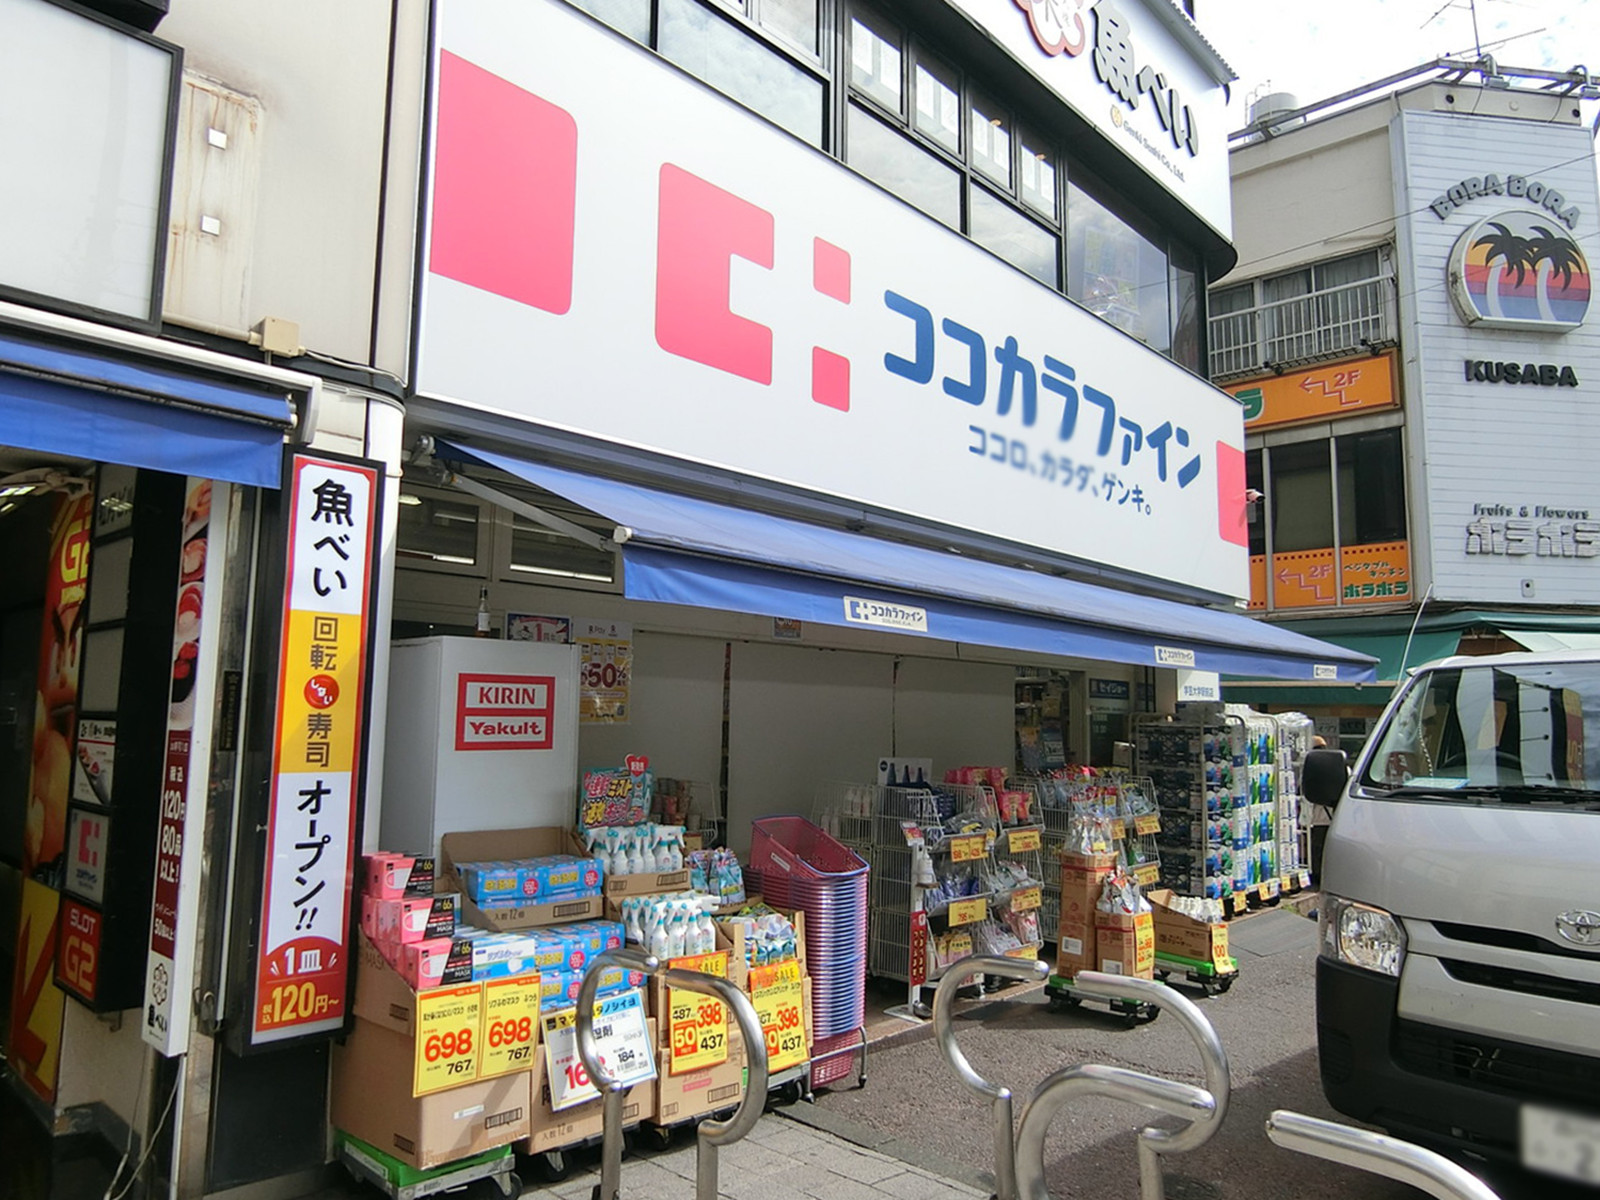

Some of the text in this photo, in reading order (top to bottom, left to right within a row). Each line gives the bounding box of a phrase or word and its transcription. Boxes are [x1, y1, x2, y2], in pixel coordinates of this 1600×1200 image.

[1430, 174, 1581, 230] BORA BORA
[1334, 369, 1361, 388] 2F
[1464, 360, 1579, 387] KUSABA
[884, 289, 1201, 488] ココカラファイン
[1473, 504, 1513, 517] Fruits
[1535, 505, 1589, 519] Flowers
[311, 479, 354, 597] 魚べい
[1308, 564, 1333, 579] 2F
[871, 605, 923, 622] ココカラファイン
[479, 686, 536, 705] KIRIN
[469, 721, 542, 736] Yakult
[70, 907, 96, 935] SLOT
[65, 936, 96, 992] G2
[284, 947, 322, 976] 1皿
[774, 968, 795, 982] SALE
[697, 1002, 722, 1029] 398
[776, 1006, 799, 1032] 398
[488, 1017, 532, 1048] 698
[674, 1026, 696, 1049] 50
[700, 1034, 724, 1050] 437
[424, 1028, 472, 1062] 698
[507, 1046, 530, 1061] 767
[782, 1036, 801, 1052] 437
[618, 1049, 635, 1063] 184
[447, 1059, 472, 1075] 767
